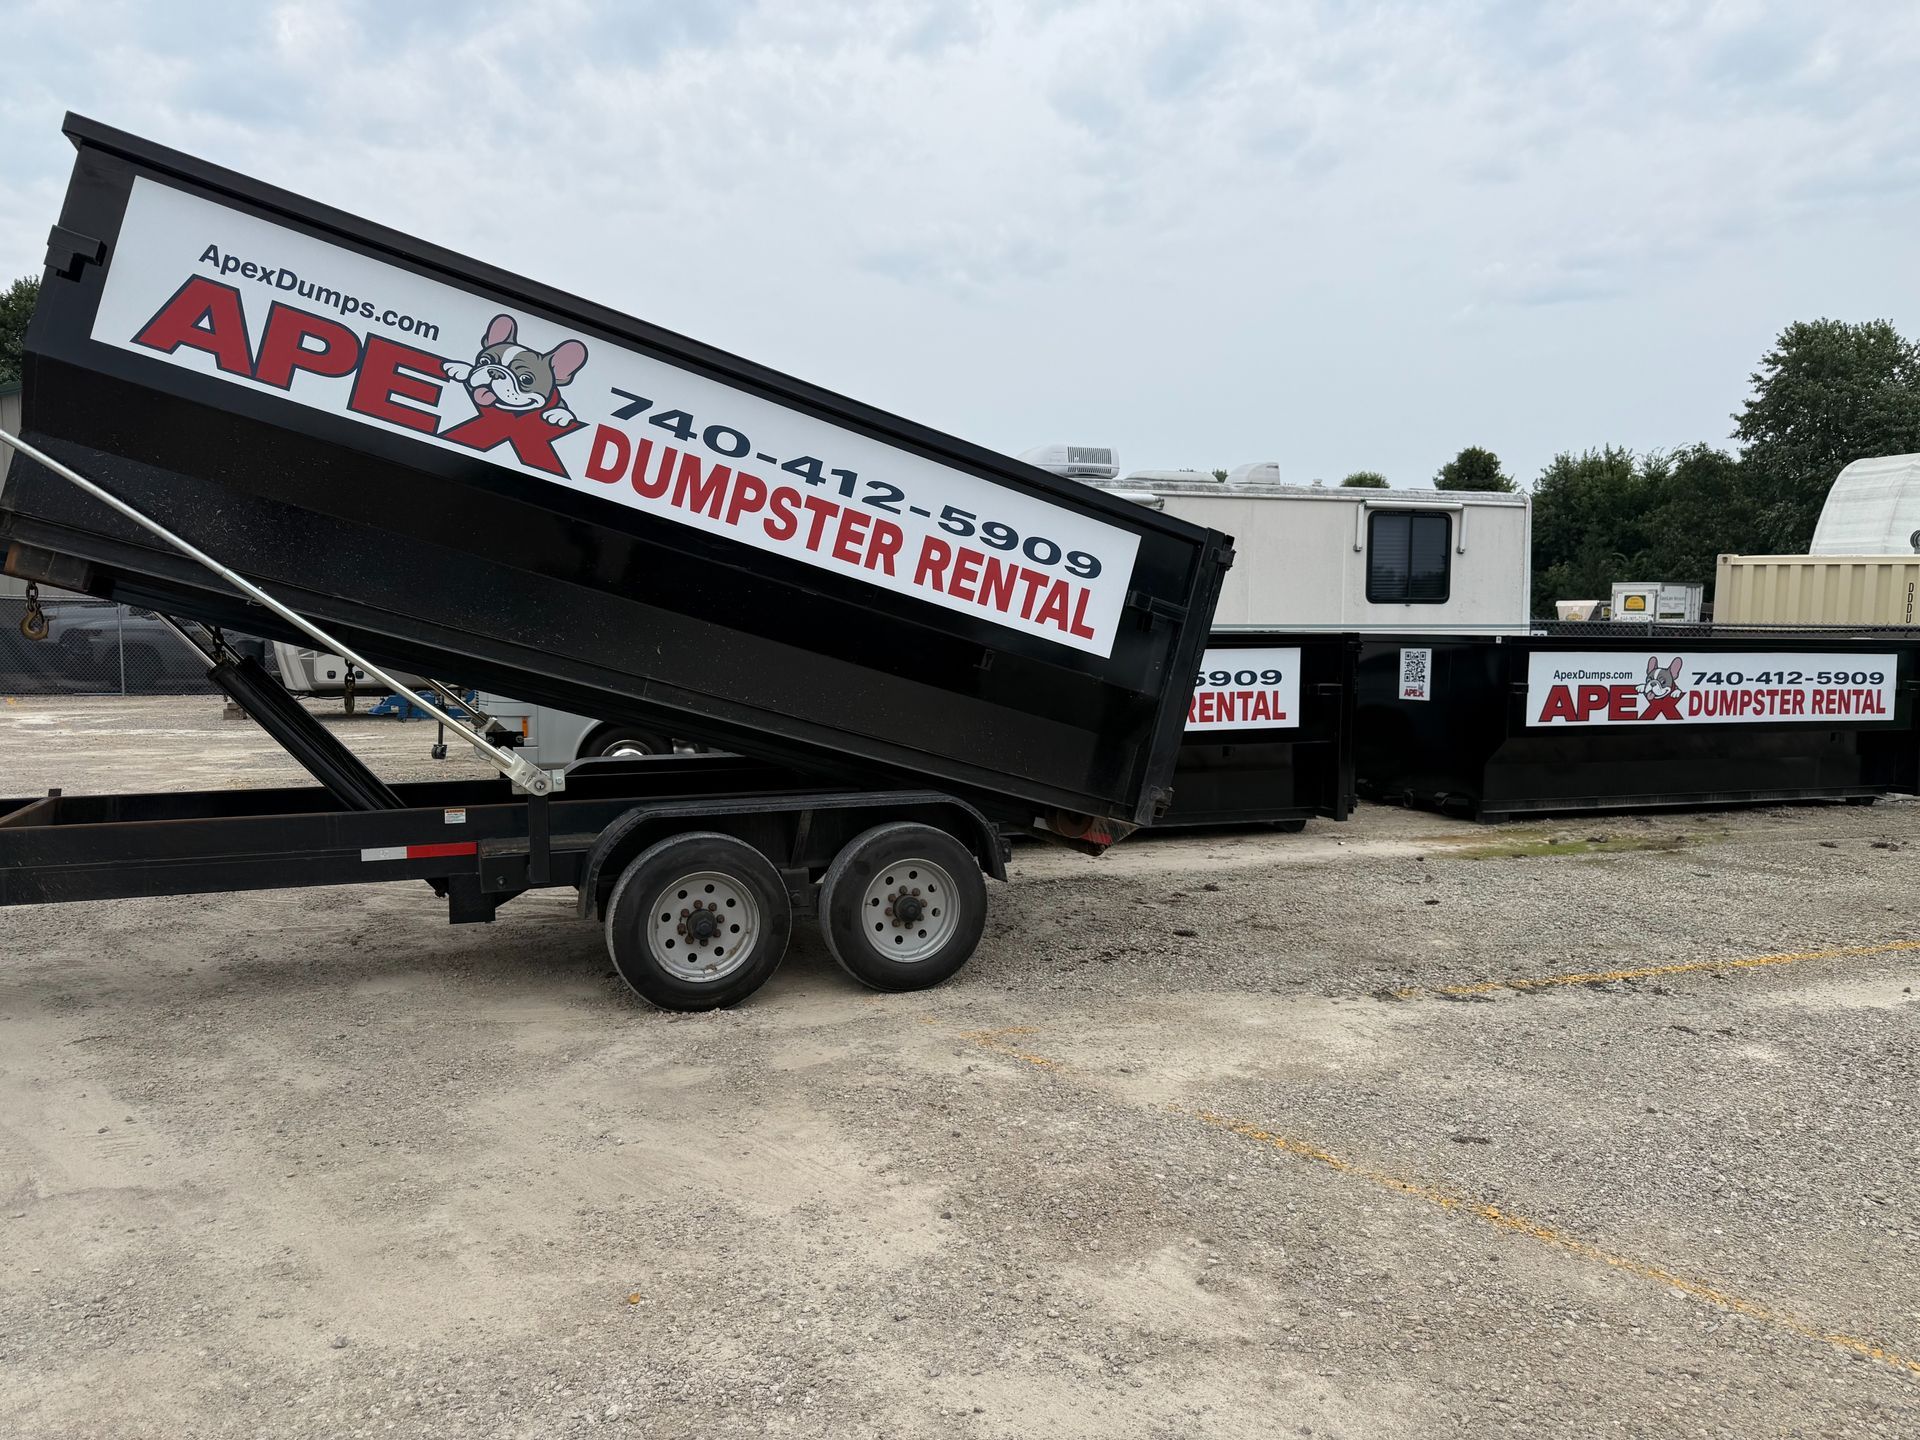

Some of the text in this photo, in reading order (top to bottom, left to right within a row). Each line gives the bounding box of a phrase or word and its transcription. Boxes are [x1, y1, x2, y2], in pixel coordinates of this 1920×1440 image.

[198, 244, 440, 341] ApexDumps.com
[129, 273, 590, 480] APEX
[609, 387, 1102, 580] 740-412-5909
[584, 423, 1095, 641] DUMPSTER RENTAL
[1538, 684, 1687, 723] APEX
[1553, 669, 1633, 682] ApexDumps.com
[1688, 688, 1887, 716] DUMPSTER RENTAL
[1691, 671, 1885, 686] 740-412-5909
